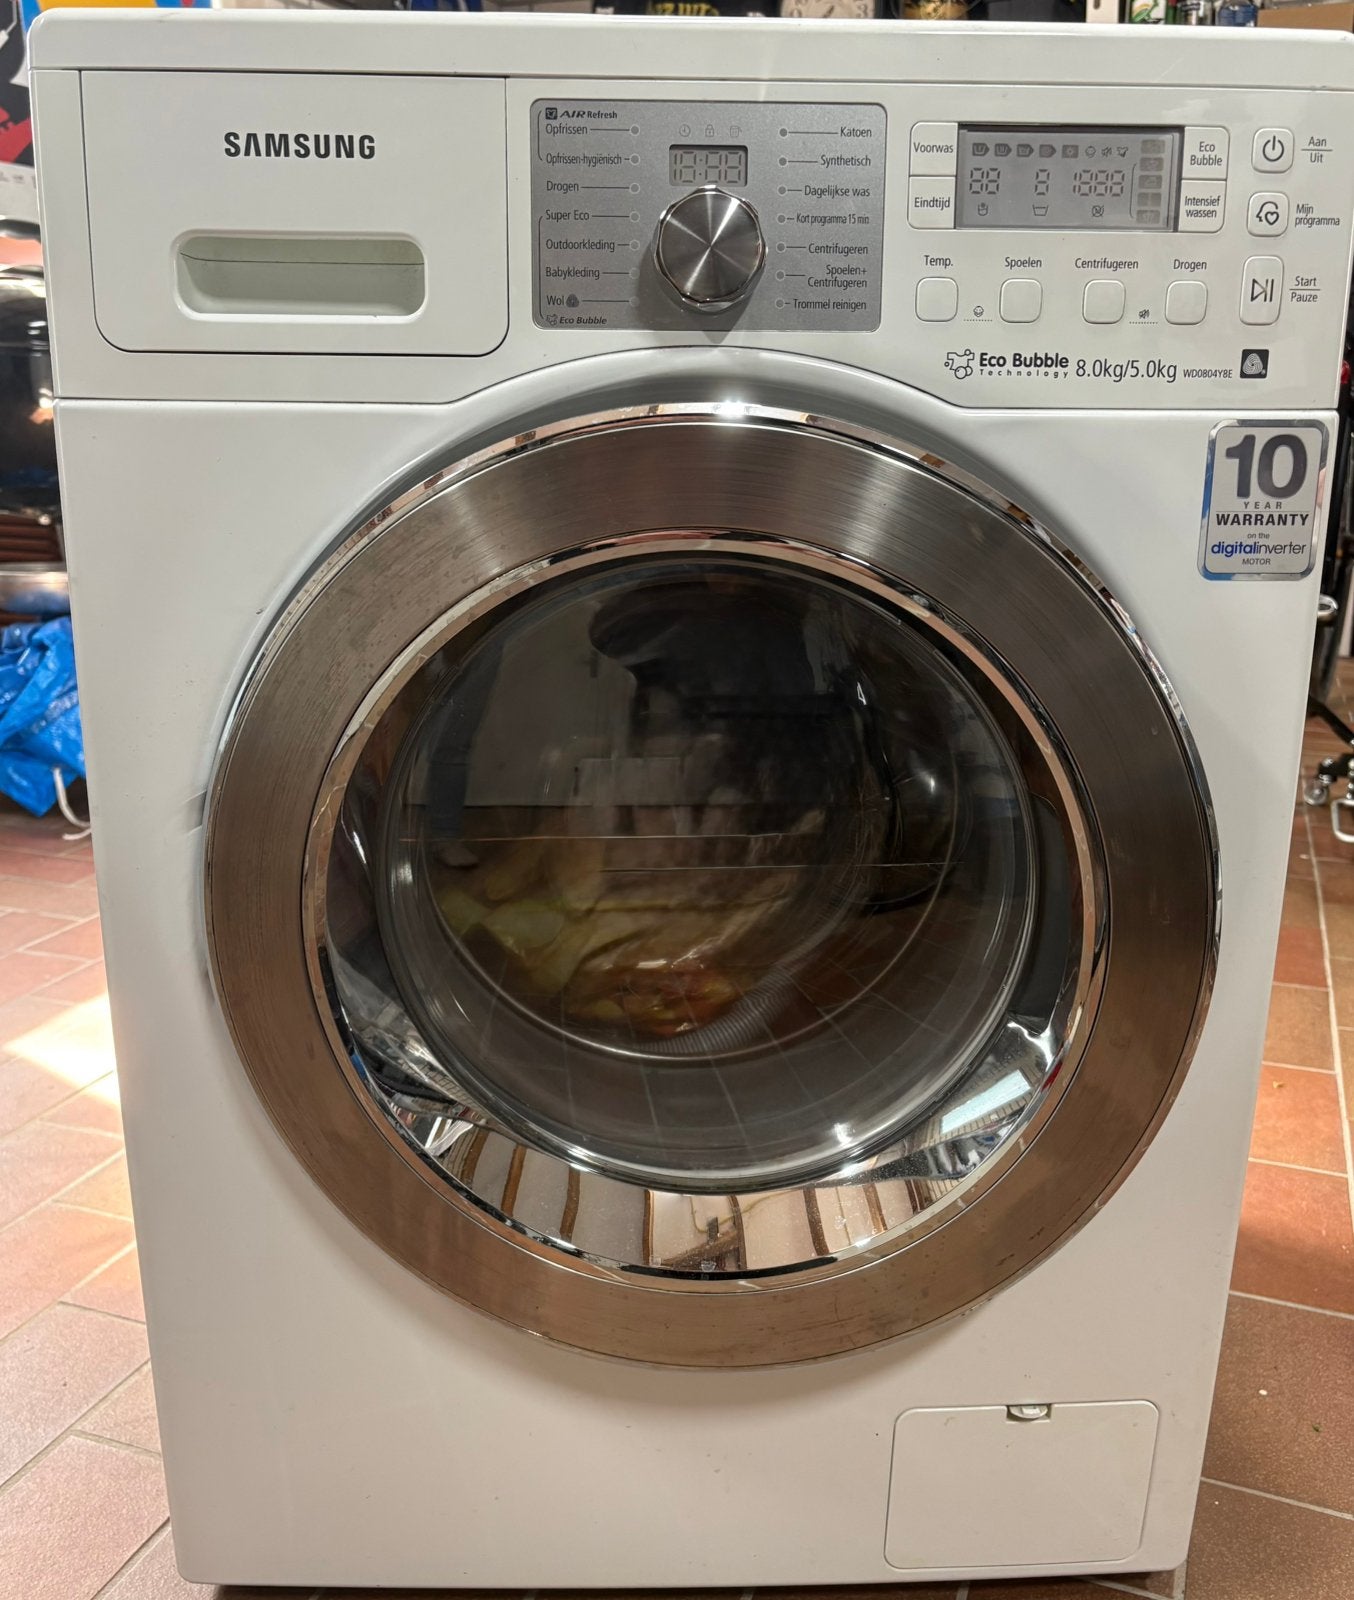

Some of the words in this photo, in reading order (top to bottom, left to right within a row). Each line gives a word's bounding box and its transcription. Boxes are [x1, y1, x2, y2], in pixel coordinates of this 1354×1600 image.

[560, 110, 586, 118] AIR
[587, 110, 618, 119] Refresh
[545, 123, 588, 136] Opfrissen
[840, 126, 872, 138] Katoen
[224, 131, 376, 160] SAMSUNG
[913, 142, 954, 154] Voorwas
[1199, 141, 1216, 152] Eco
[1308, 136, 1327, 147] Aan
[820, 154, 871, 168] Synthetisch
[1189, 154, 1223, 166] Bubble
[1309, 153, 1324, 164] Uit
[546, 180, 579, 194] Drogen
[804, 184, 850, 199] Dagelijkse
[851, 189, 871, 197] was
[914, 196, 951, 211] Eindtijd
[1184, 195, 1221, 207] Intensief
[545, 209, 571, 222] Super
[573, 209, 590, 221] Eco
[1185, 209, 1217, 218] wassen
[1296, 203, 1314, 216] Mijn
[796, 212, 810, 224] Kort
[810, 214, 847, 226] programma
[848, 213, 857, 225] 15
[857, 214, 870, 224] min
[1294, 215, 1340, 229] programma
[545, 238, 616, 253] Outdoorkleding
[808, 242, 869, 257] Centrifugeren
[924, 255, 954, 268] Temp.
[1004, 256, 1042, 270] Spoelen
[1075, 258, 1139, 272] Centrifugeren
[1173, 258, 1208, 272] Drogen
[545, 266, 600, 280] Babykleding
[825, 264, 868, 278] Spoelen+
[807, 276, 868, 291] Centrifugeren
[1294, 275, 1317, 287] Start
[546, 295, 565, 306] Wol
[1290, 293, 1318, 303] Pauze
[793, 298, 831, 310] Trommel
[832, 299, 867, 312] reinigen
[559, 316, 575, 324] Eco
[576, 316, 608, 325] Bubble
[979, 352, 1007, 367] Eco
[1011, 352, 1070, 369] Bubble
[1075, 358, 1178, 384] 8.0kg/5.0kg
[1183, 368, 1233, 379] WD0804Y8E
[980, 369, 1069, 379] Technology
[1225, 433, 1308, 499] 10
[1243, 501, 1283, 510] YEAR
[1215, 513, 1310, 526] WARRANTY
[1258, 532, 1271, 540] the
[1210, 541, 1307, 558] digitalinverter
[1241, 558, 1272, 566] MOTOR
